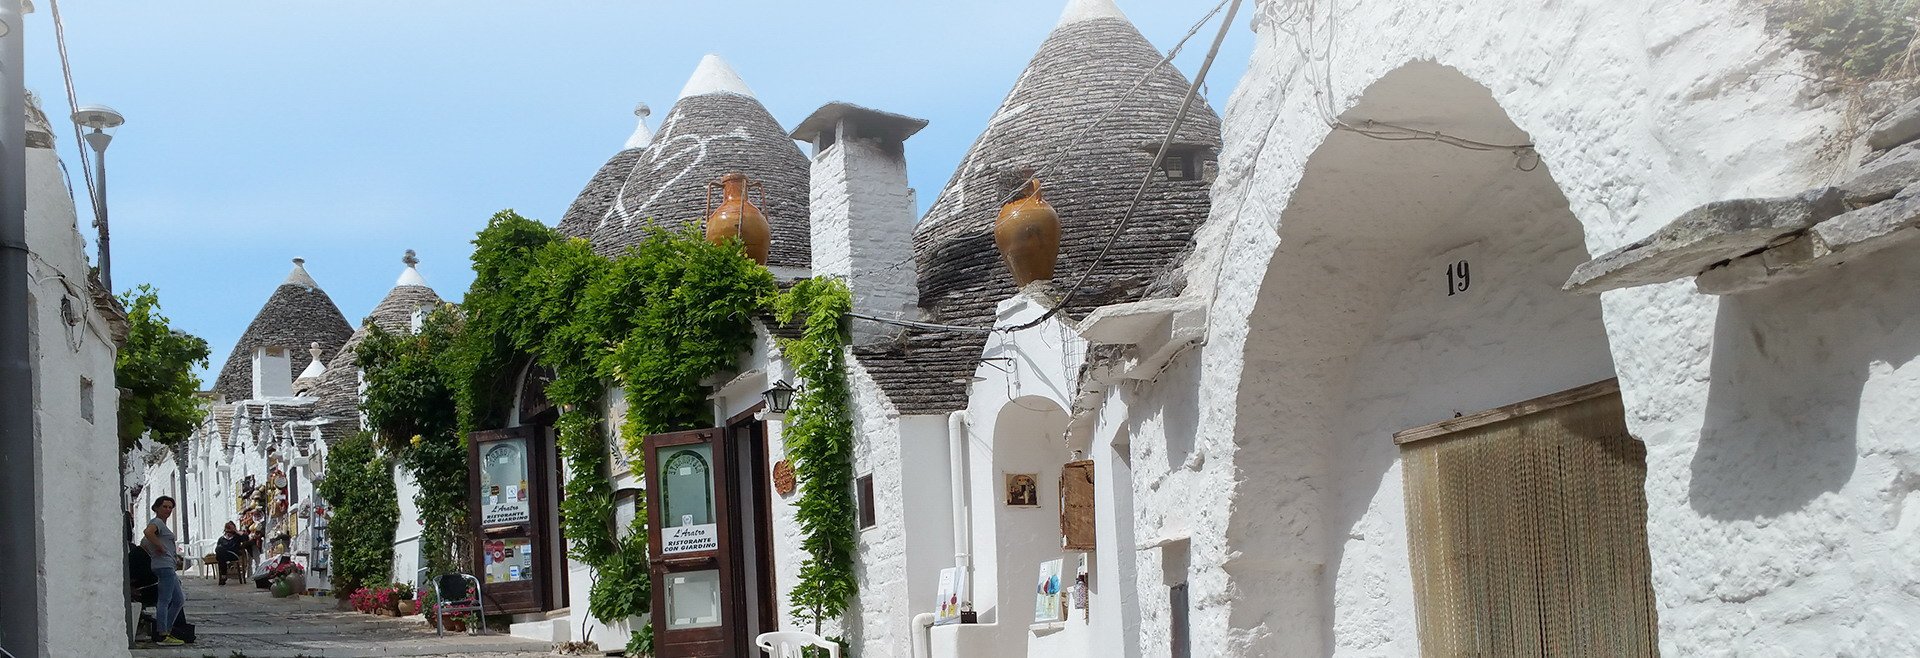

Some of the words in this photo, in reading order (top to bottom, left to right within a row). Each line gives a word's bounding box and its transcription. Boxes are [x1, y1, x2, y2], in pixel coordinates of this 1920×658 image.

[1446, 260, 1470, 296] 19
[673, 528, 705, 538] L'Aratro
[668, 538, 711, 546] RISTORANTE
[681, 543, 716, 551] GIARDINO
